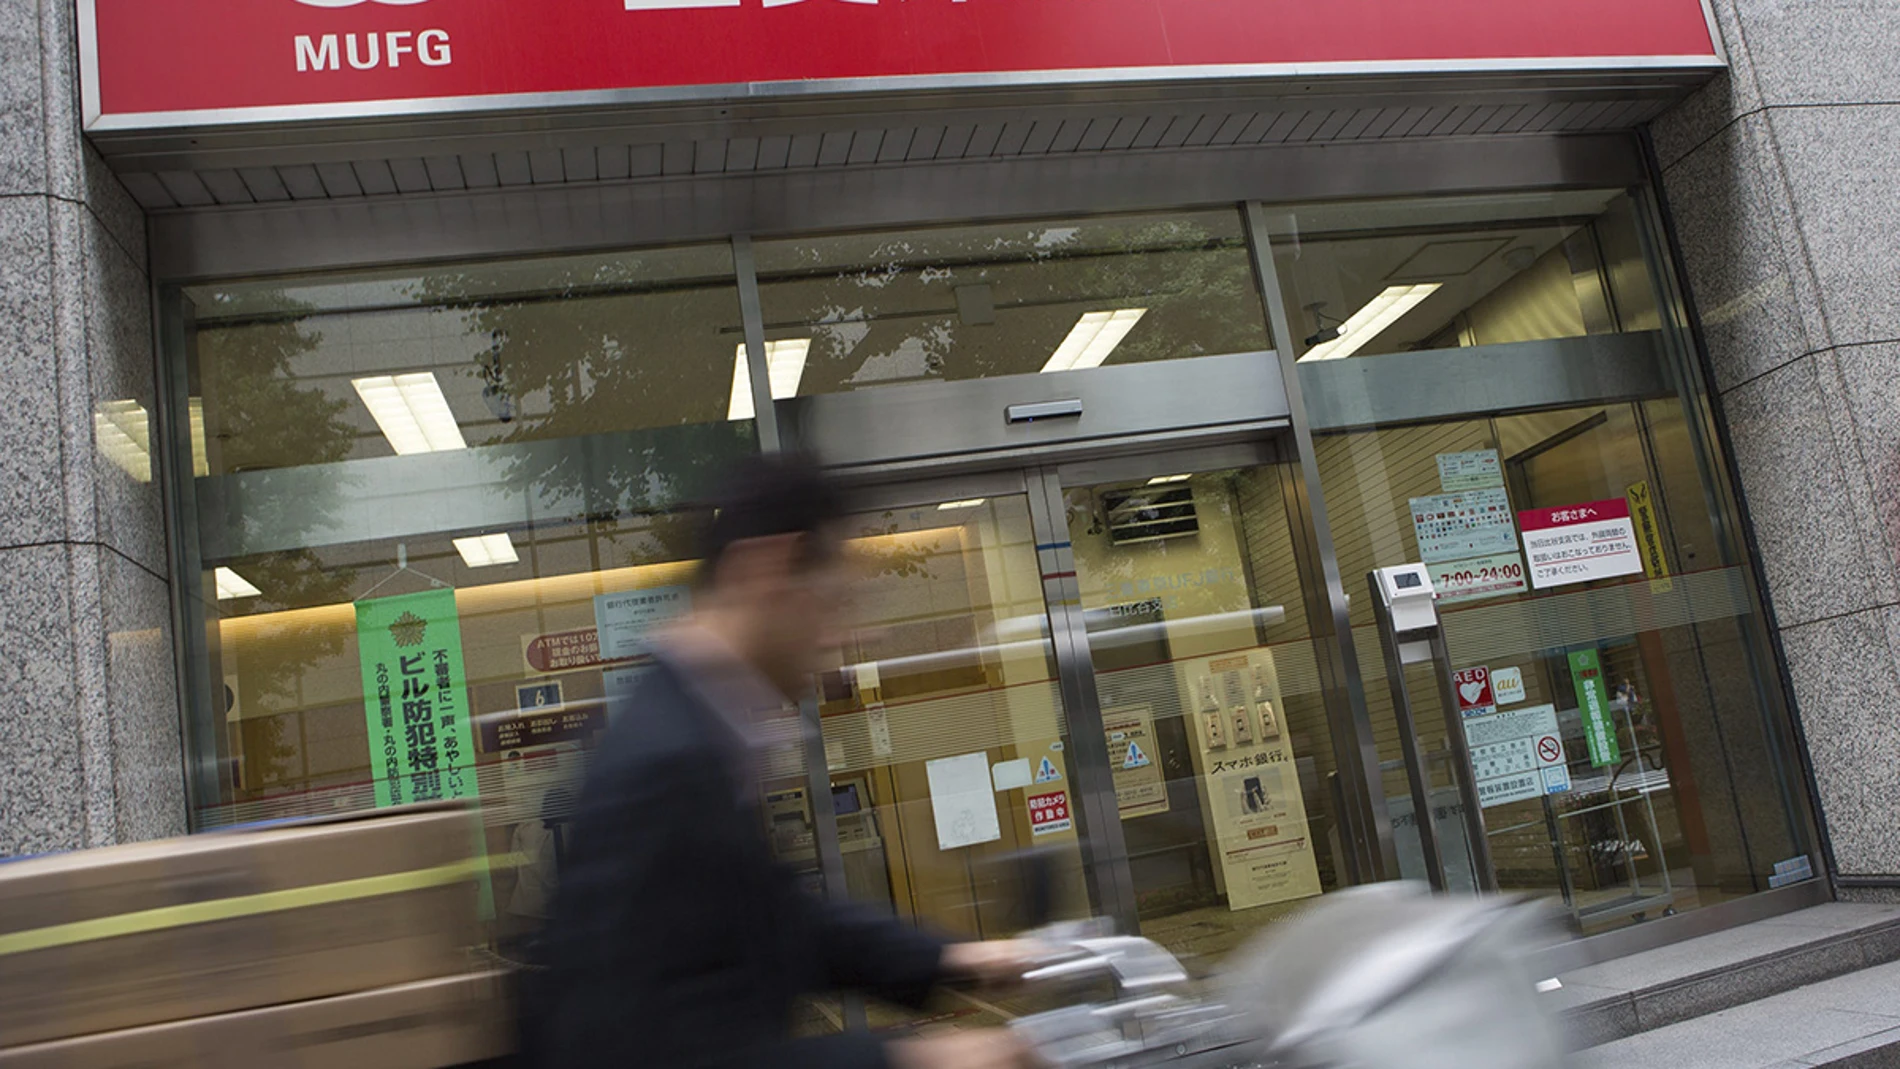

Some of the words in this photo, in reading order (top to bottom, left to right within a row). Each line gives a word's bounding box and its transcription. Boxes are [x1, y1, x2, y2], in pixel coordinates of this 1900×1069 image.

[295, 29, 452, 72] MUFG
[1551, 507, 1598, 523] お客さまへ
[1453, 669, 1485, 683] AED
[1497, 677, 1520, 691] au
[535, 689, 545, 707] 6
